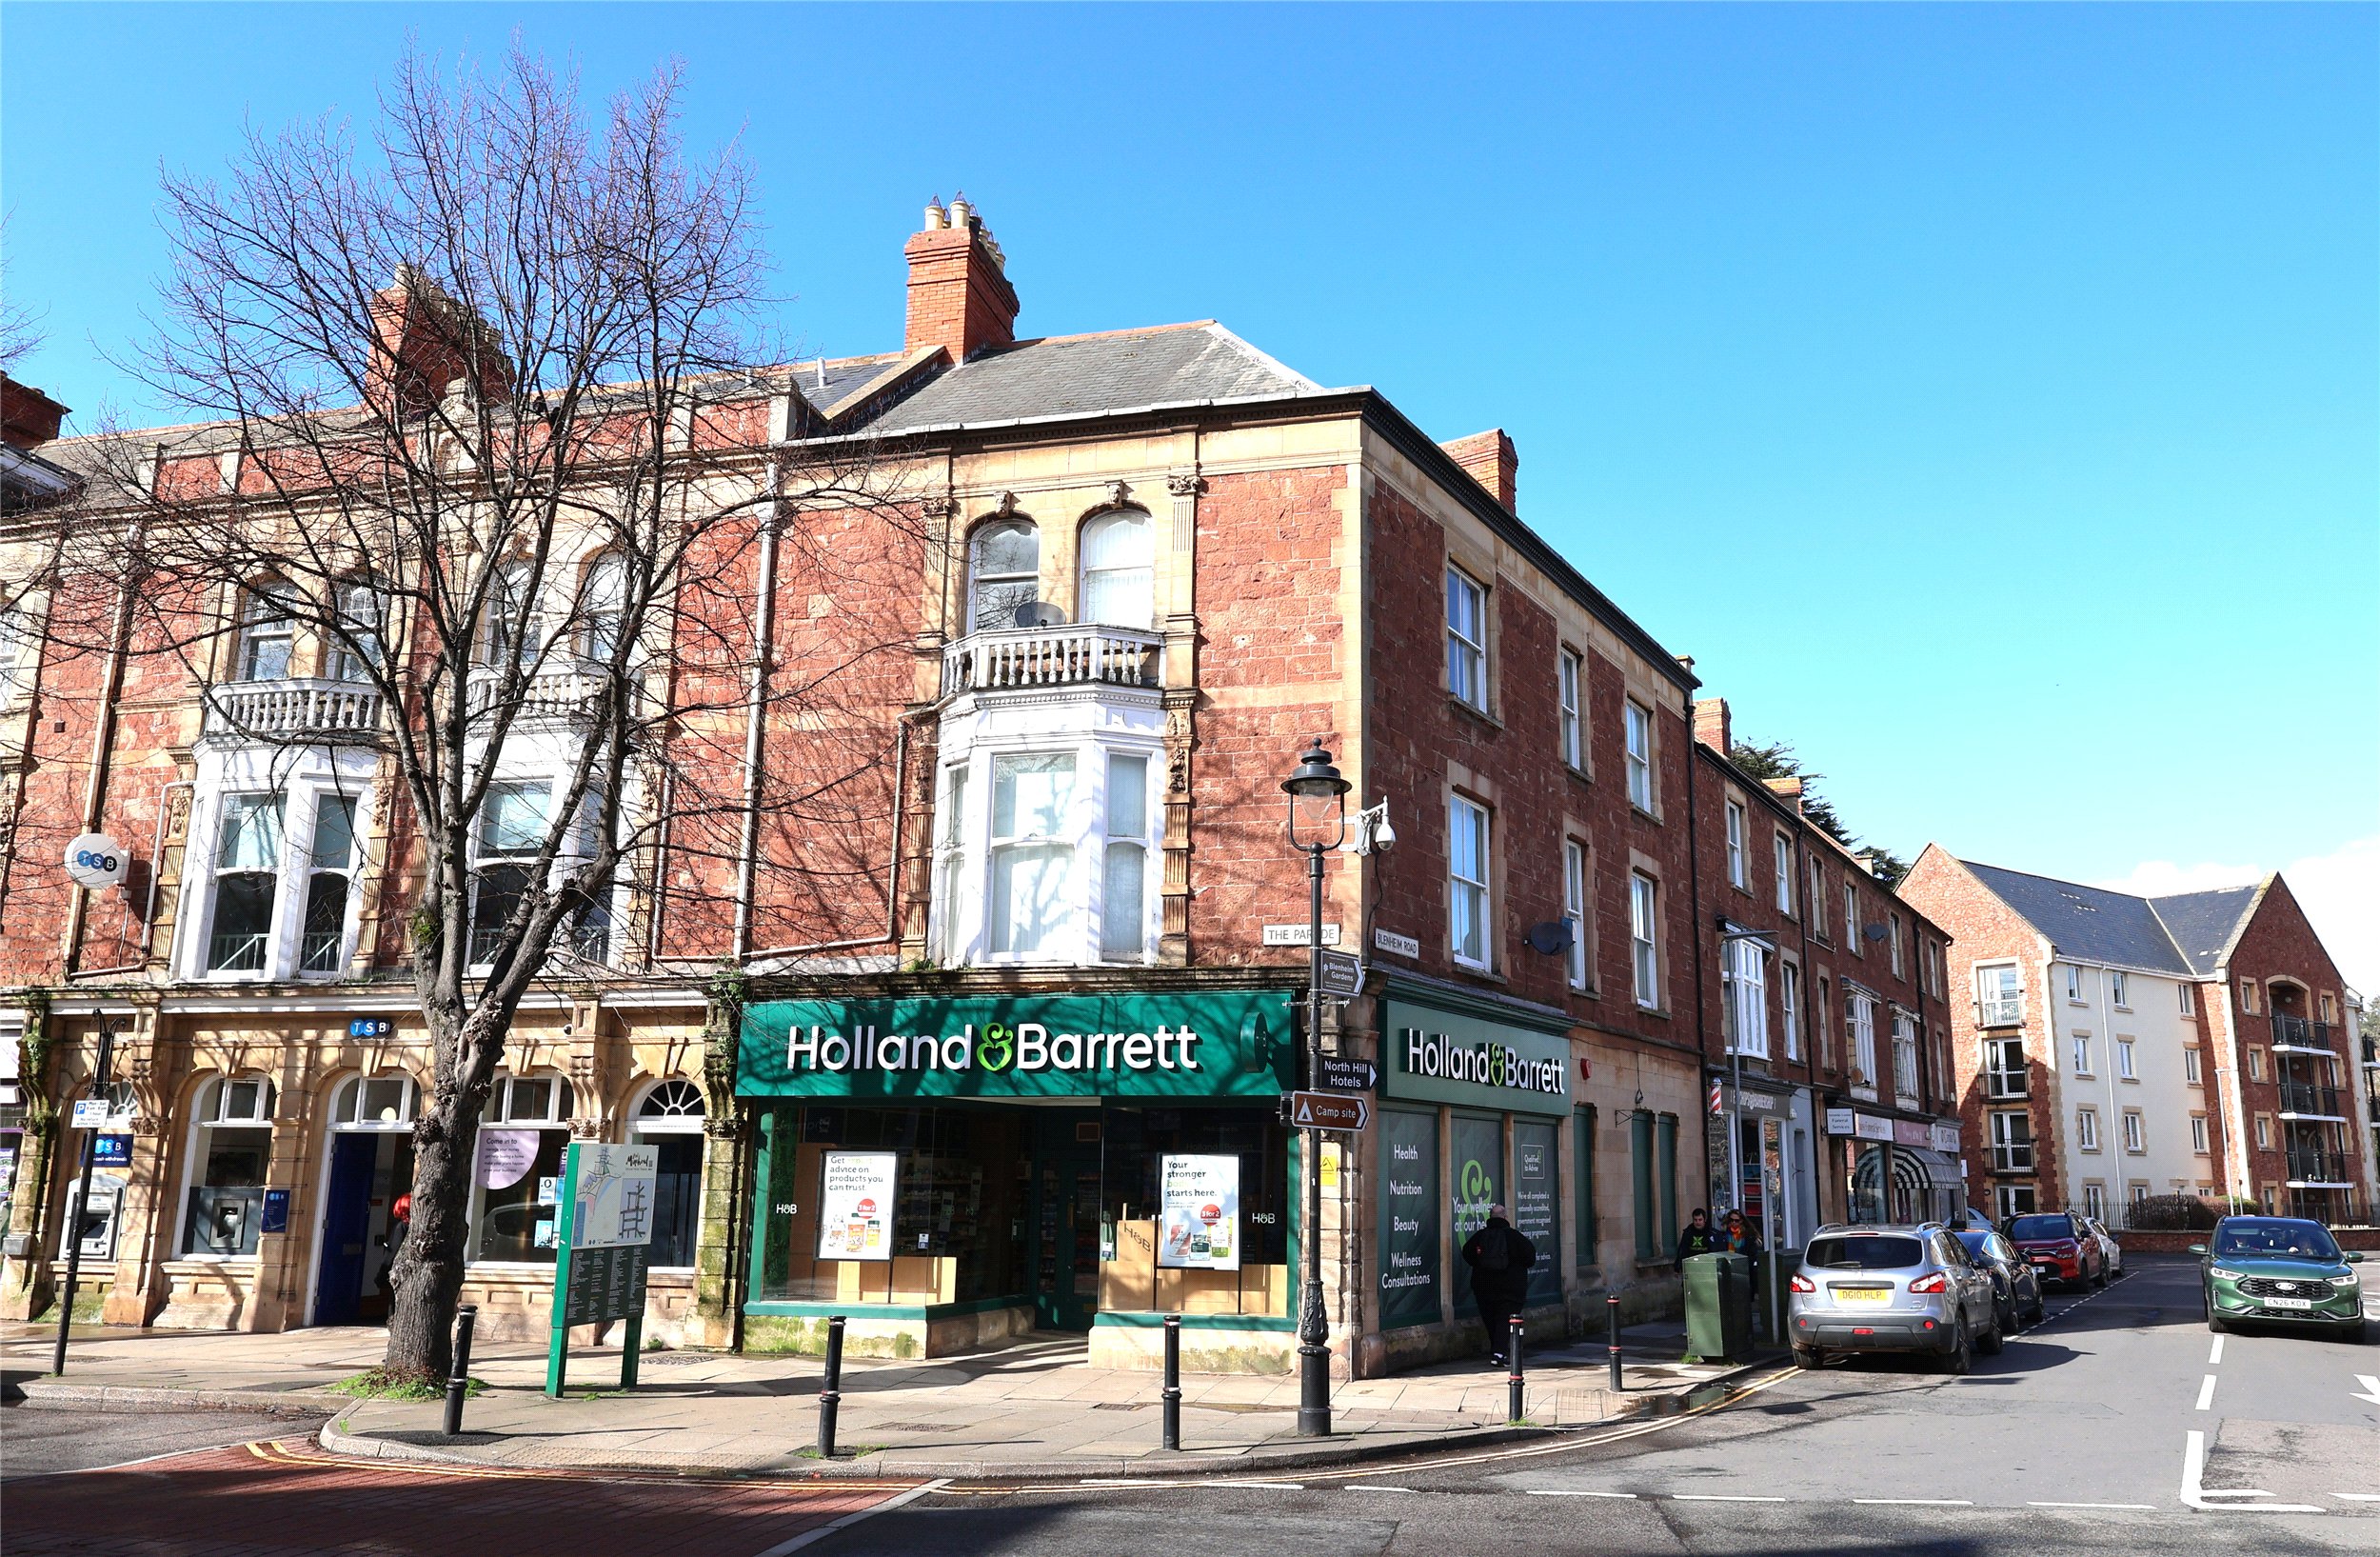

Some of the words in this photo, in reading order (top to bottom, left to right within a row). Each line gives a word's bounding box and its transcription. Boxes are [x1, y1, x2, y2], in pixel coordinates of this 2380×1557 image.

[80, 851, 115, 870] TSB
[1268, 929, 1288, 940] THE
[1294, 929, 1334, 939] PARDE
[1378, 932, 1402, 948] BLENHEIM
[1404, 940, 1417, 953] ROAD
[1329, 962, 1354, 973] Blenheim
[1331, 971, 1353, 982] Gardens
[352, 1021, 387, 1034] TSB
[786, 1024, 971, 1069] Holland
[1017, 1023, 1198, 1069] Barrett
[1325, 1060, 1350, 1072] North
[1353, 1063, 1368, 1074] Hill
[1409, 1028, 1489, 1084] Holland
[1505, 1046, 1565, 1095] Barrett
[1330, 1075, 1361, 1088] Hotels
[1316, 1105, 1339, 1118] Camp
[1341, 1109, 1356, 1119] site
[1394, 1144, 1418, 1160] Health
[1168, 1161, 1188, 1169] Your
[829, 1175, 866, 1183] products
[1167, 1171, 1207, 1179] stronger
[1194, 1189, 1217, 1197] here.
[1390, 1179, 1422, 1195] Nutrition
[776, 1203, 798, 1214] H&B
[1452, 1197, 1468, 1214] Your
[1252, 1213, 1276, 1224] H&B
[1394, 1216, 1419, 1236] Beauty
[1454, 1220, 1462, 1232] at
[1464, 1221, 1476, 1231] our
[1391, 1252, 1422, 1268] Wellness
[1382, 1270, 1430, 1289] Consultations
[1864, 1291, 1882, 1300] HLP
[2268, 1298, 2289, 1307] CN26
